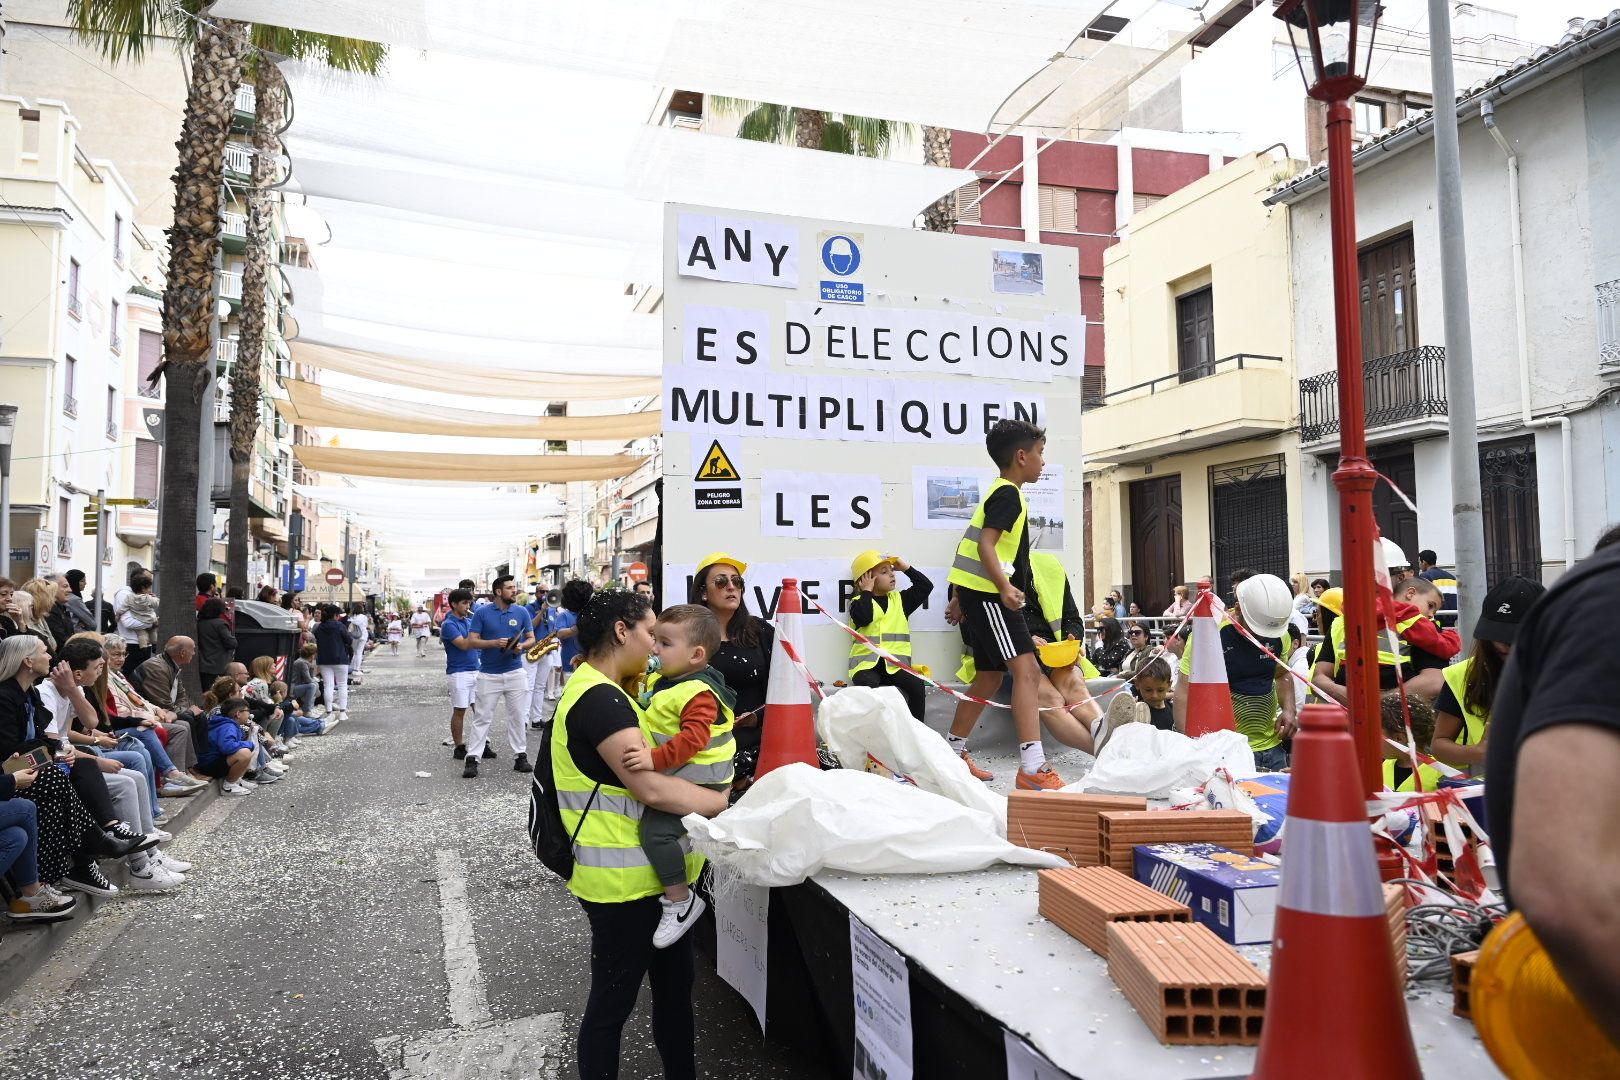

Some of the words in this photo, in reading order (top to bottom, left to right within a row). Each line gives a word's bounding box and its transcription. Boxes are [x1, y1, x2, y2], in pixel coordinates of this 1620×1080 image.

[687, 226, 789, 277] ANY
[821, 287, 862, 296] OBLIGATORIO
[696, 327, 758, 365] ES
[671, 387, 1039, 439] MULTIPLIQUEN
[775, 492, 872, 530] LES
